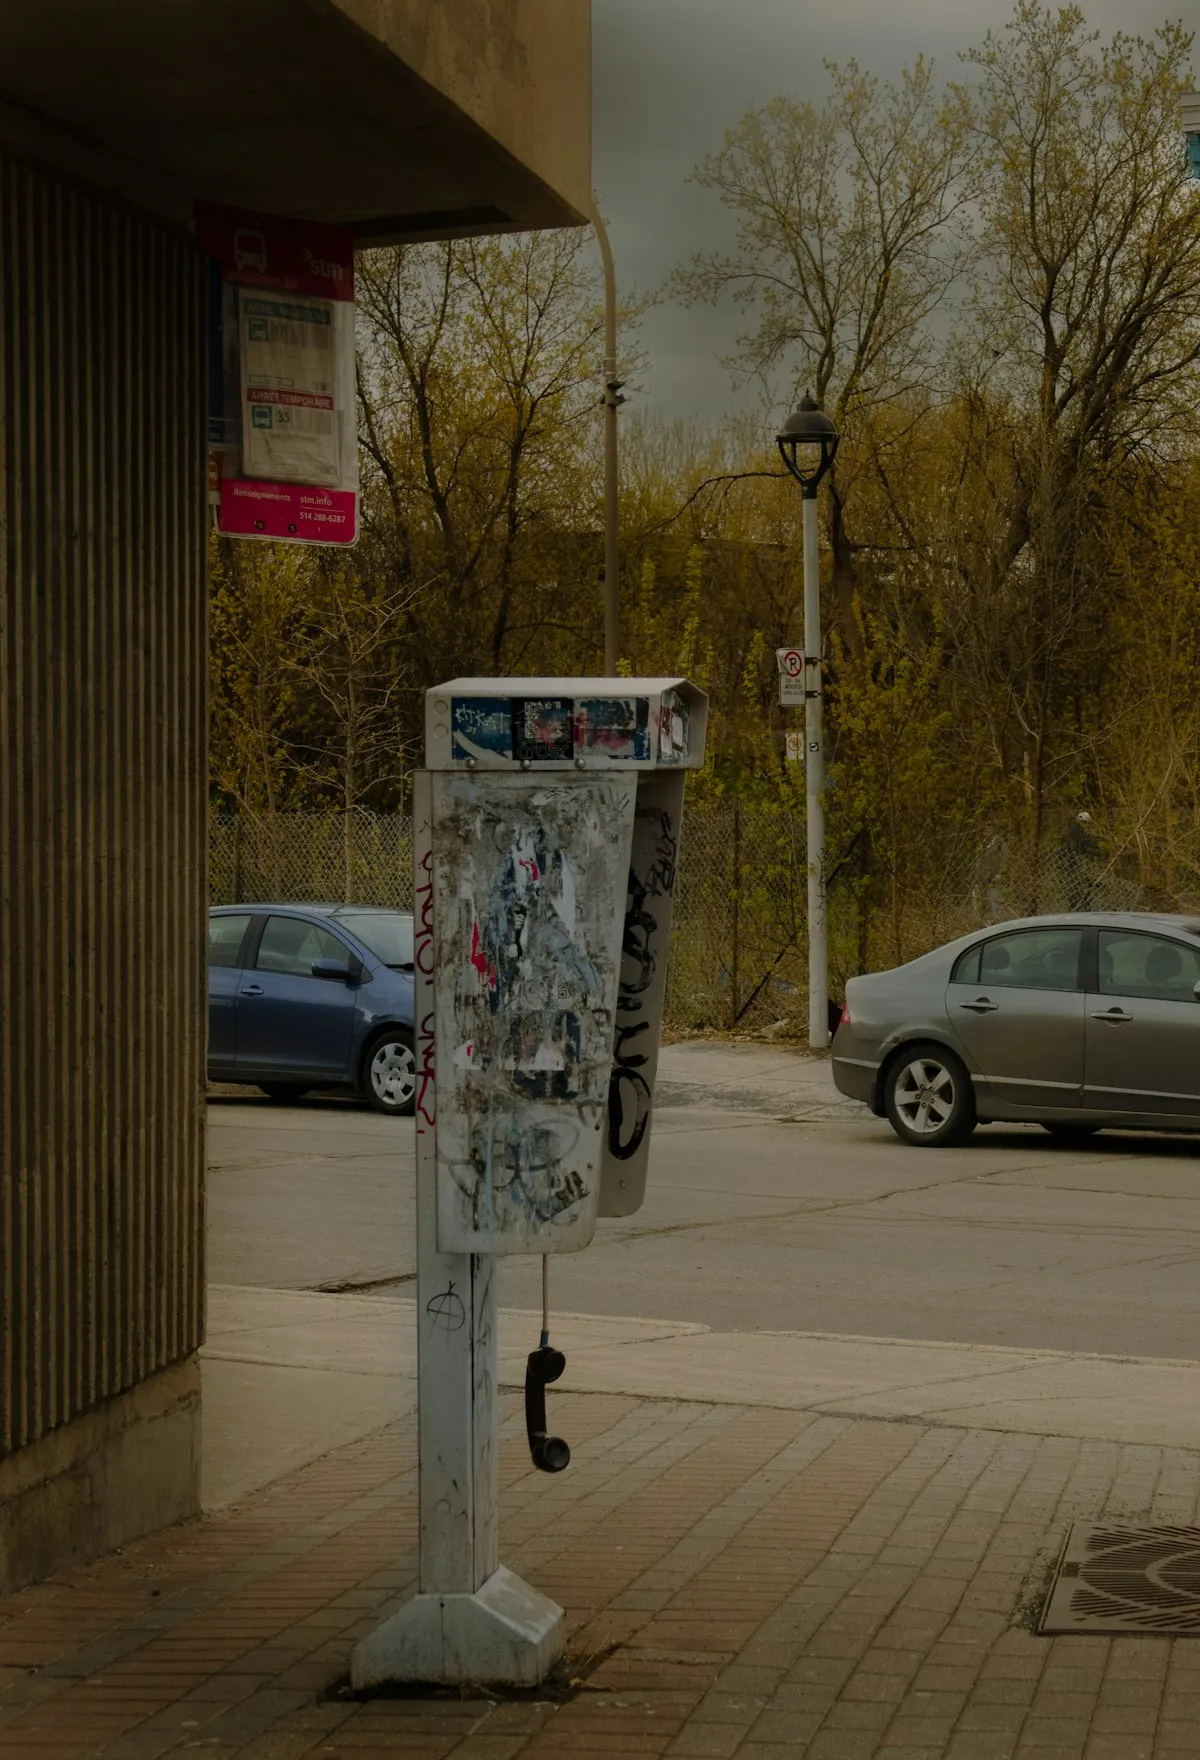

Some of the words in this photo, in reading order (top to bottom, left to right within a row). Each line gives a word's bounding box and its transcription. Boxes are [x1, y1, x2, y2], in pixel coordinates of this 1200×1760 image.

[310, 257, 344, 281] stm
[281, 393, 331, 409] TEMPORAIRE
[277, 411, 290, 423] 35
[233, 488, 292, 502] Renseignements
[299, 496, 332, 506] stm.info
[299, 511, 312, 521] 514
[314, 513, 346, 524] 288-6287
